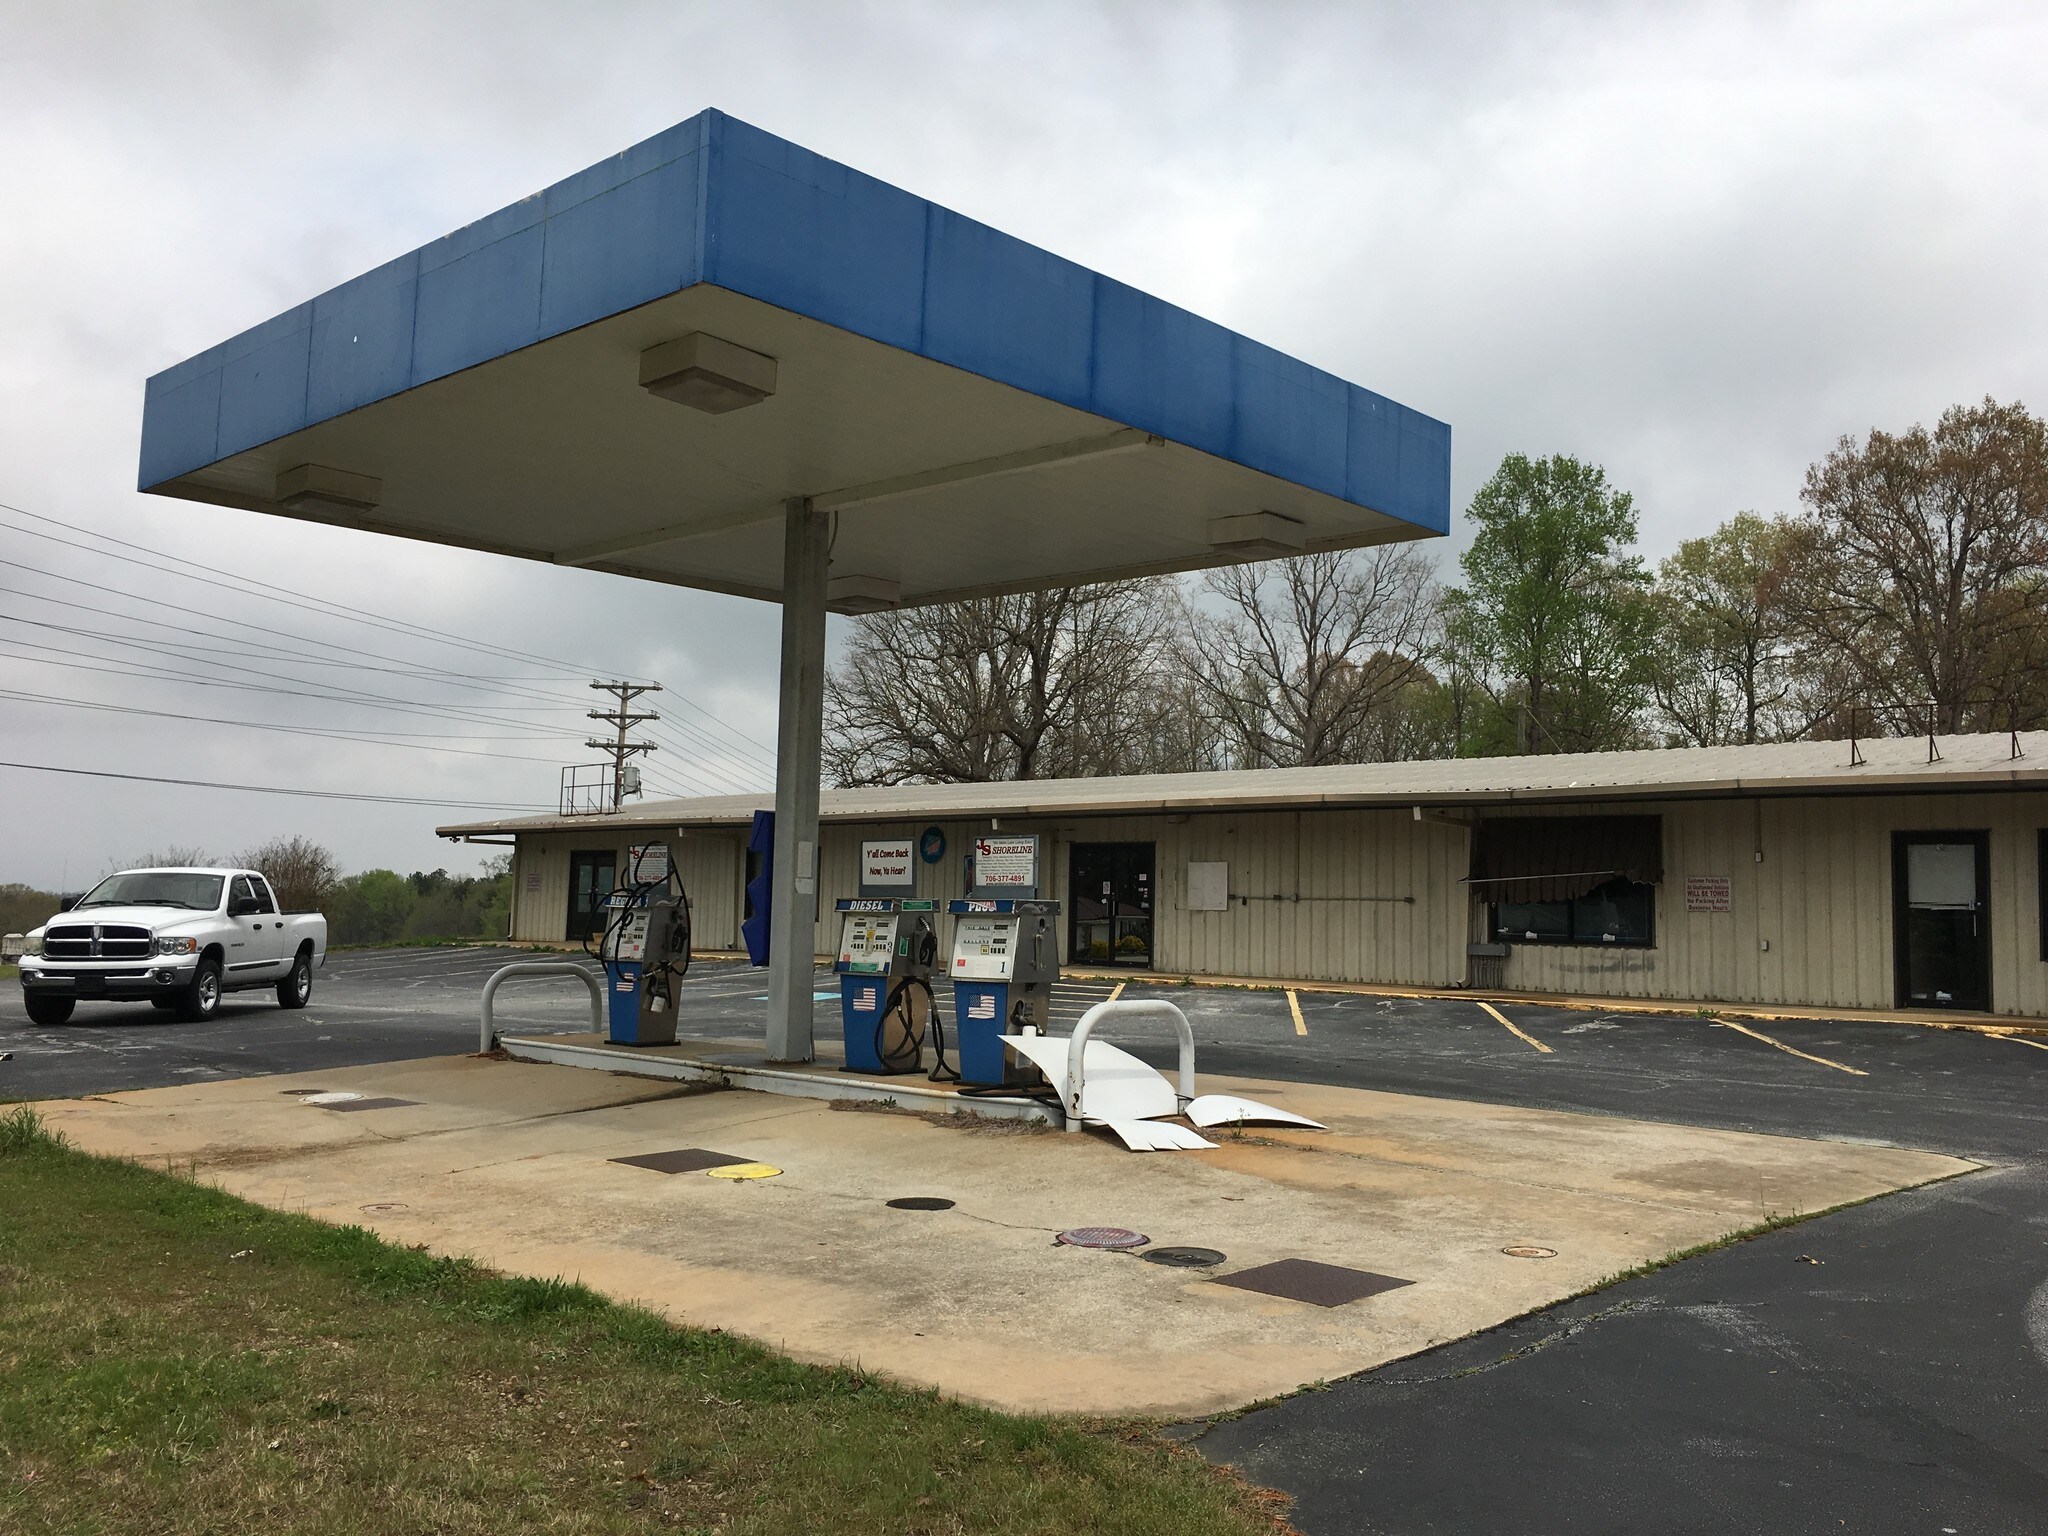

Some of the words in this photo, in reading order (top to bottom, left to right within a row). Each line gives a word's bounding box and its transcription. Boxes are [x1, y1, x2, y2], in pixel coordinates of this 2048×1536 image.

[867, 849, 880, 858] Y'all
[880, 849, 894, 858] Come
[895, 848, 909, 858] Back
[992, 846, 1033, 855] SHORELINE
[883, 866, 889, 875] Ya
[849, 900, 884, 910] DIESEL
[887, 942, 893, 954] 3
[1000, 961, 1006, 973] 1
